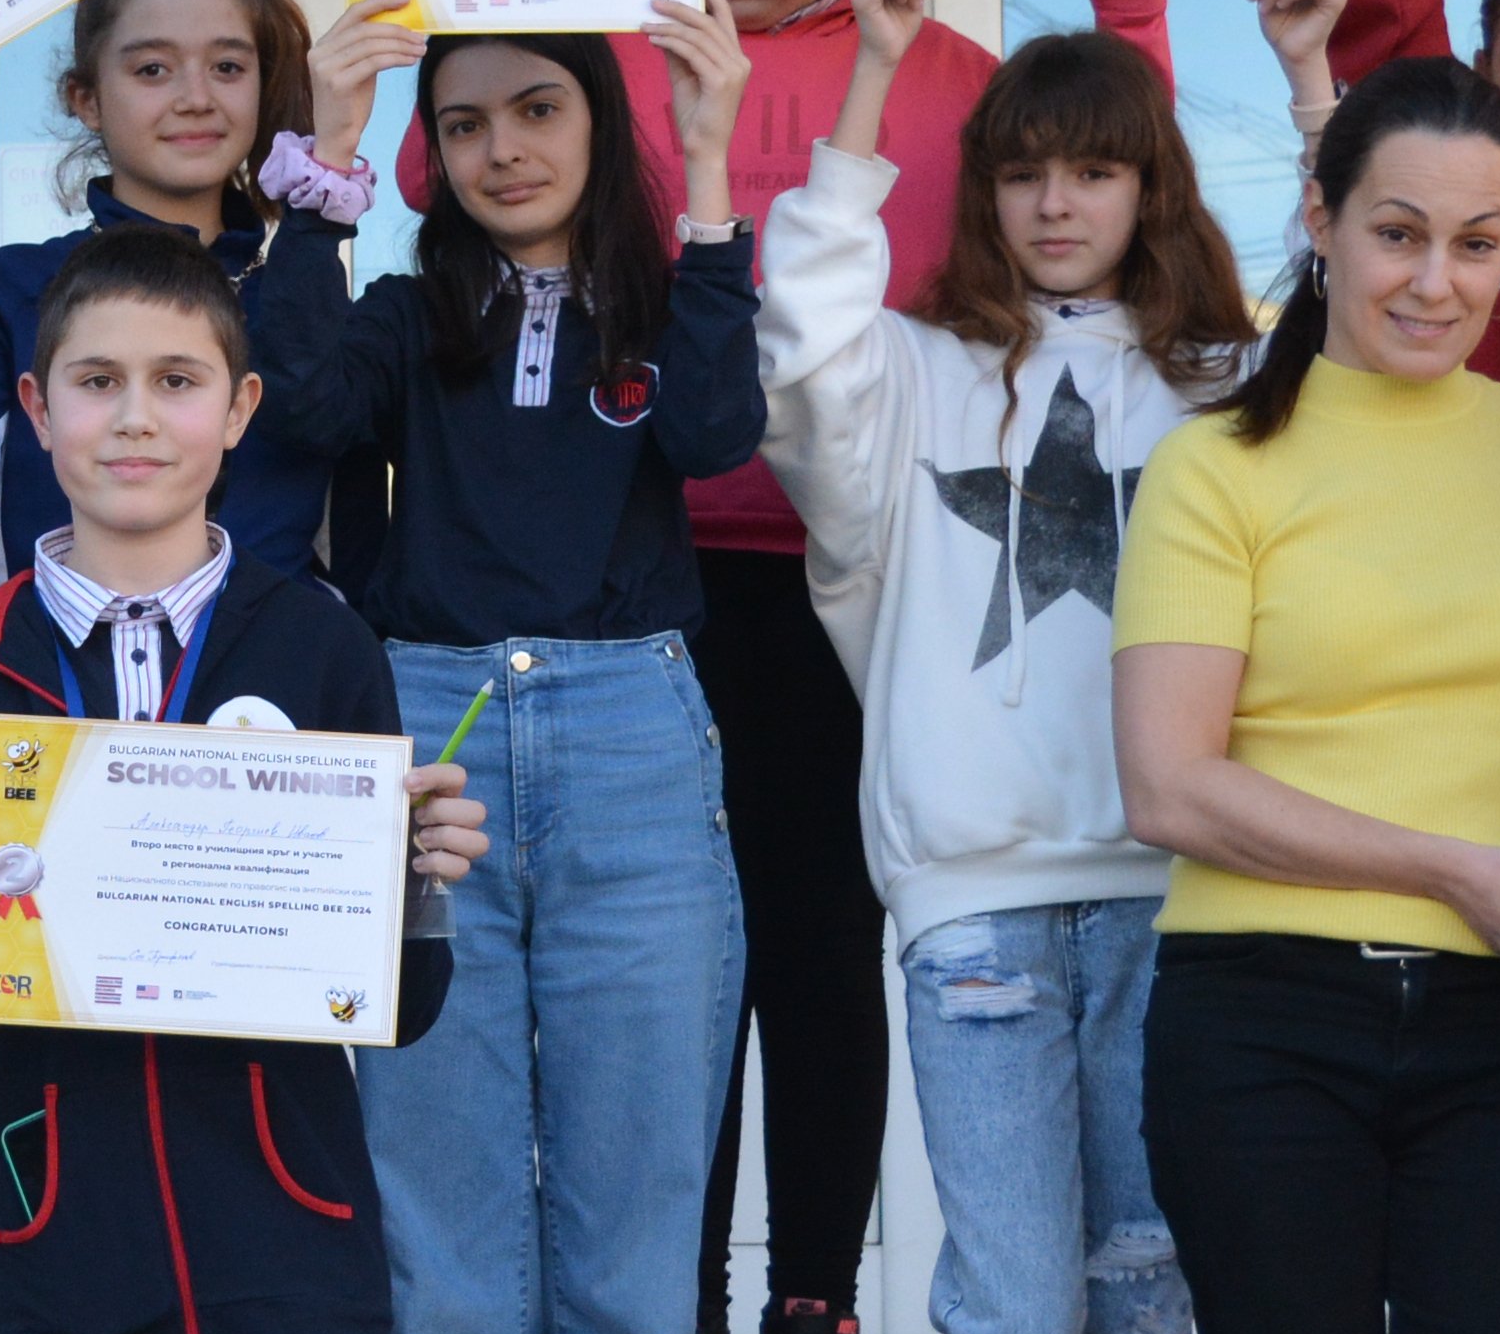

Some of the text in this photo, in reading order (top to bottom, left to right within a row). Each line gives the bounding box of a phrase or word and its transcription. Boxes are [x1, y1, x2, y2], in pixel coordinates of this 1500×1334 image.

[108, 744, 378, 769] BULGARIAN NATIONAL ENGLISH SPELLING BEE
[107, 761, 375, 797] SCHOOL WINNER
[4, 788, 36, 800] BEE
[130, 839, 162, 853] Второ
[162, 843, 194, 852] място
[195, 845, 203, 853] в
[203, 845, 265, 858] училищния
[265, 848, 291, 859] кръг
[301, 850, 343, 862] участие
[162, 860, 310, 878] в регионална квалификация
[229, 882, 242, 890] по
[242, 883, 288, 894] правопис
[288, 885, 301, 893] на
[96, 891, 372, 915] BULGARIAN NATIONAL ENGLISH SPELLING BEE 2024
[164, 921, 288, 936] CONGRATULATIONS!
